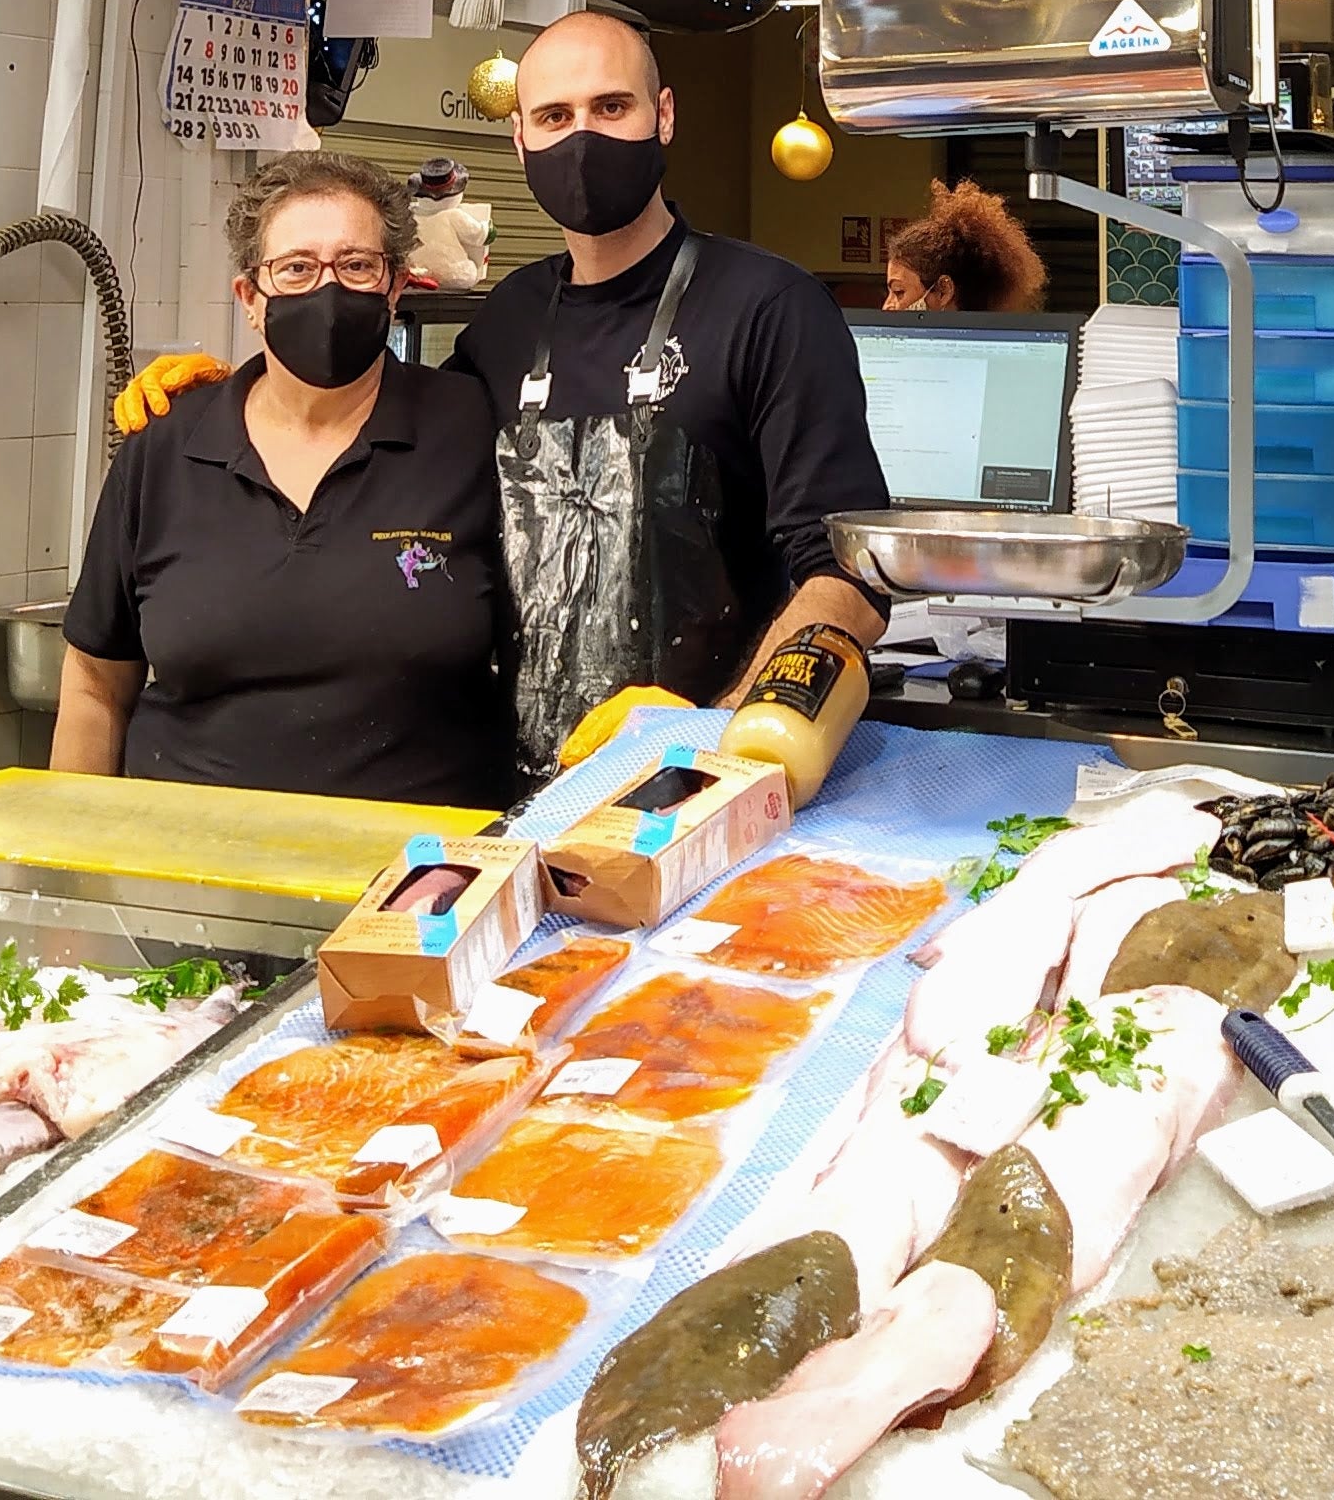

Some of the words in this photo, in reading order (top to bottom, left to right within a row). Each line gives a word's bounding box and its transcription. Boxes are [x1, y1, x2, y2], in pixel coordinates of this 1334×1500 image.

[207, 15, 214, 32] 1
[224, 17, 232, 35] 2
[252, 23, 260, 40] 4
[270, 25, 278, 42] 5
[285, 28, 294, 44] 6
[183, 38, 192, 56] 7
[205, 41, 214, 59] 8
[221, 44, 227, 61] 9
[233, 46, 245, 64] 10
[251, 48, 262, 66] 11
[267, 50, 279, 68] 12
[284, 53, 296, 71] 13
[177, 65, 193, 84] 14
[201, 68, 214, 86] 15
[218, 71, 228, 88] 16
[233, 73, 246, 91] 17
[251, 75, 262, 92] 18
[266, 77, 278, 94] 19
[282, 79, 298, 96] 20
[175, 92, 192, 111] 21
[197, 94, 214, 112] 22
[216, 97, 232, 114] 23
[233, 99, 251, 116] 24
[252, 102, 267, 116] 25
[269, 103, 284, 118] 26
[284, 105, 299, 120] 27
[173, 119, 193, 138] 28
[223, 122, 242, 139] 30
[242, 123, 261, 139] 31
[767, 653, 819, 671] FUMET
[775, 666, 815, 687] PEIX
